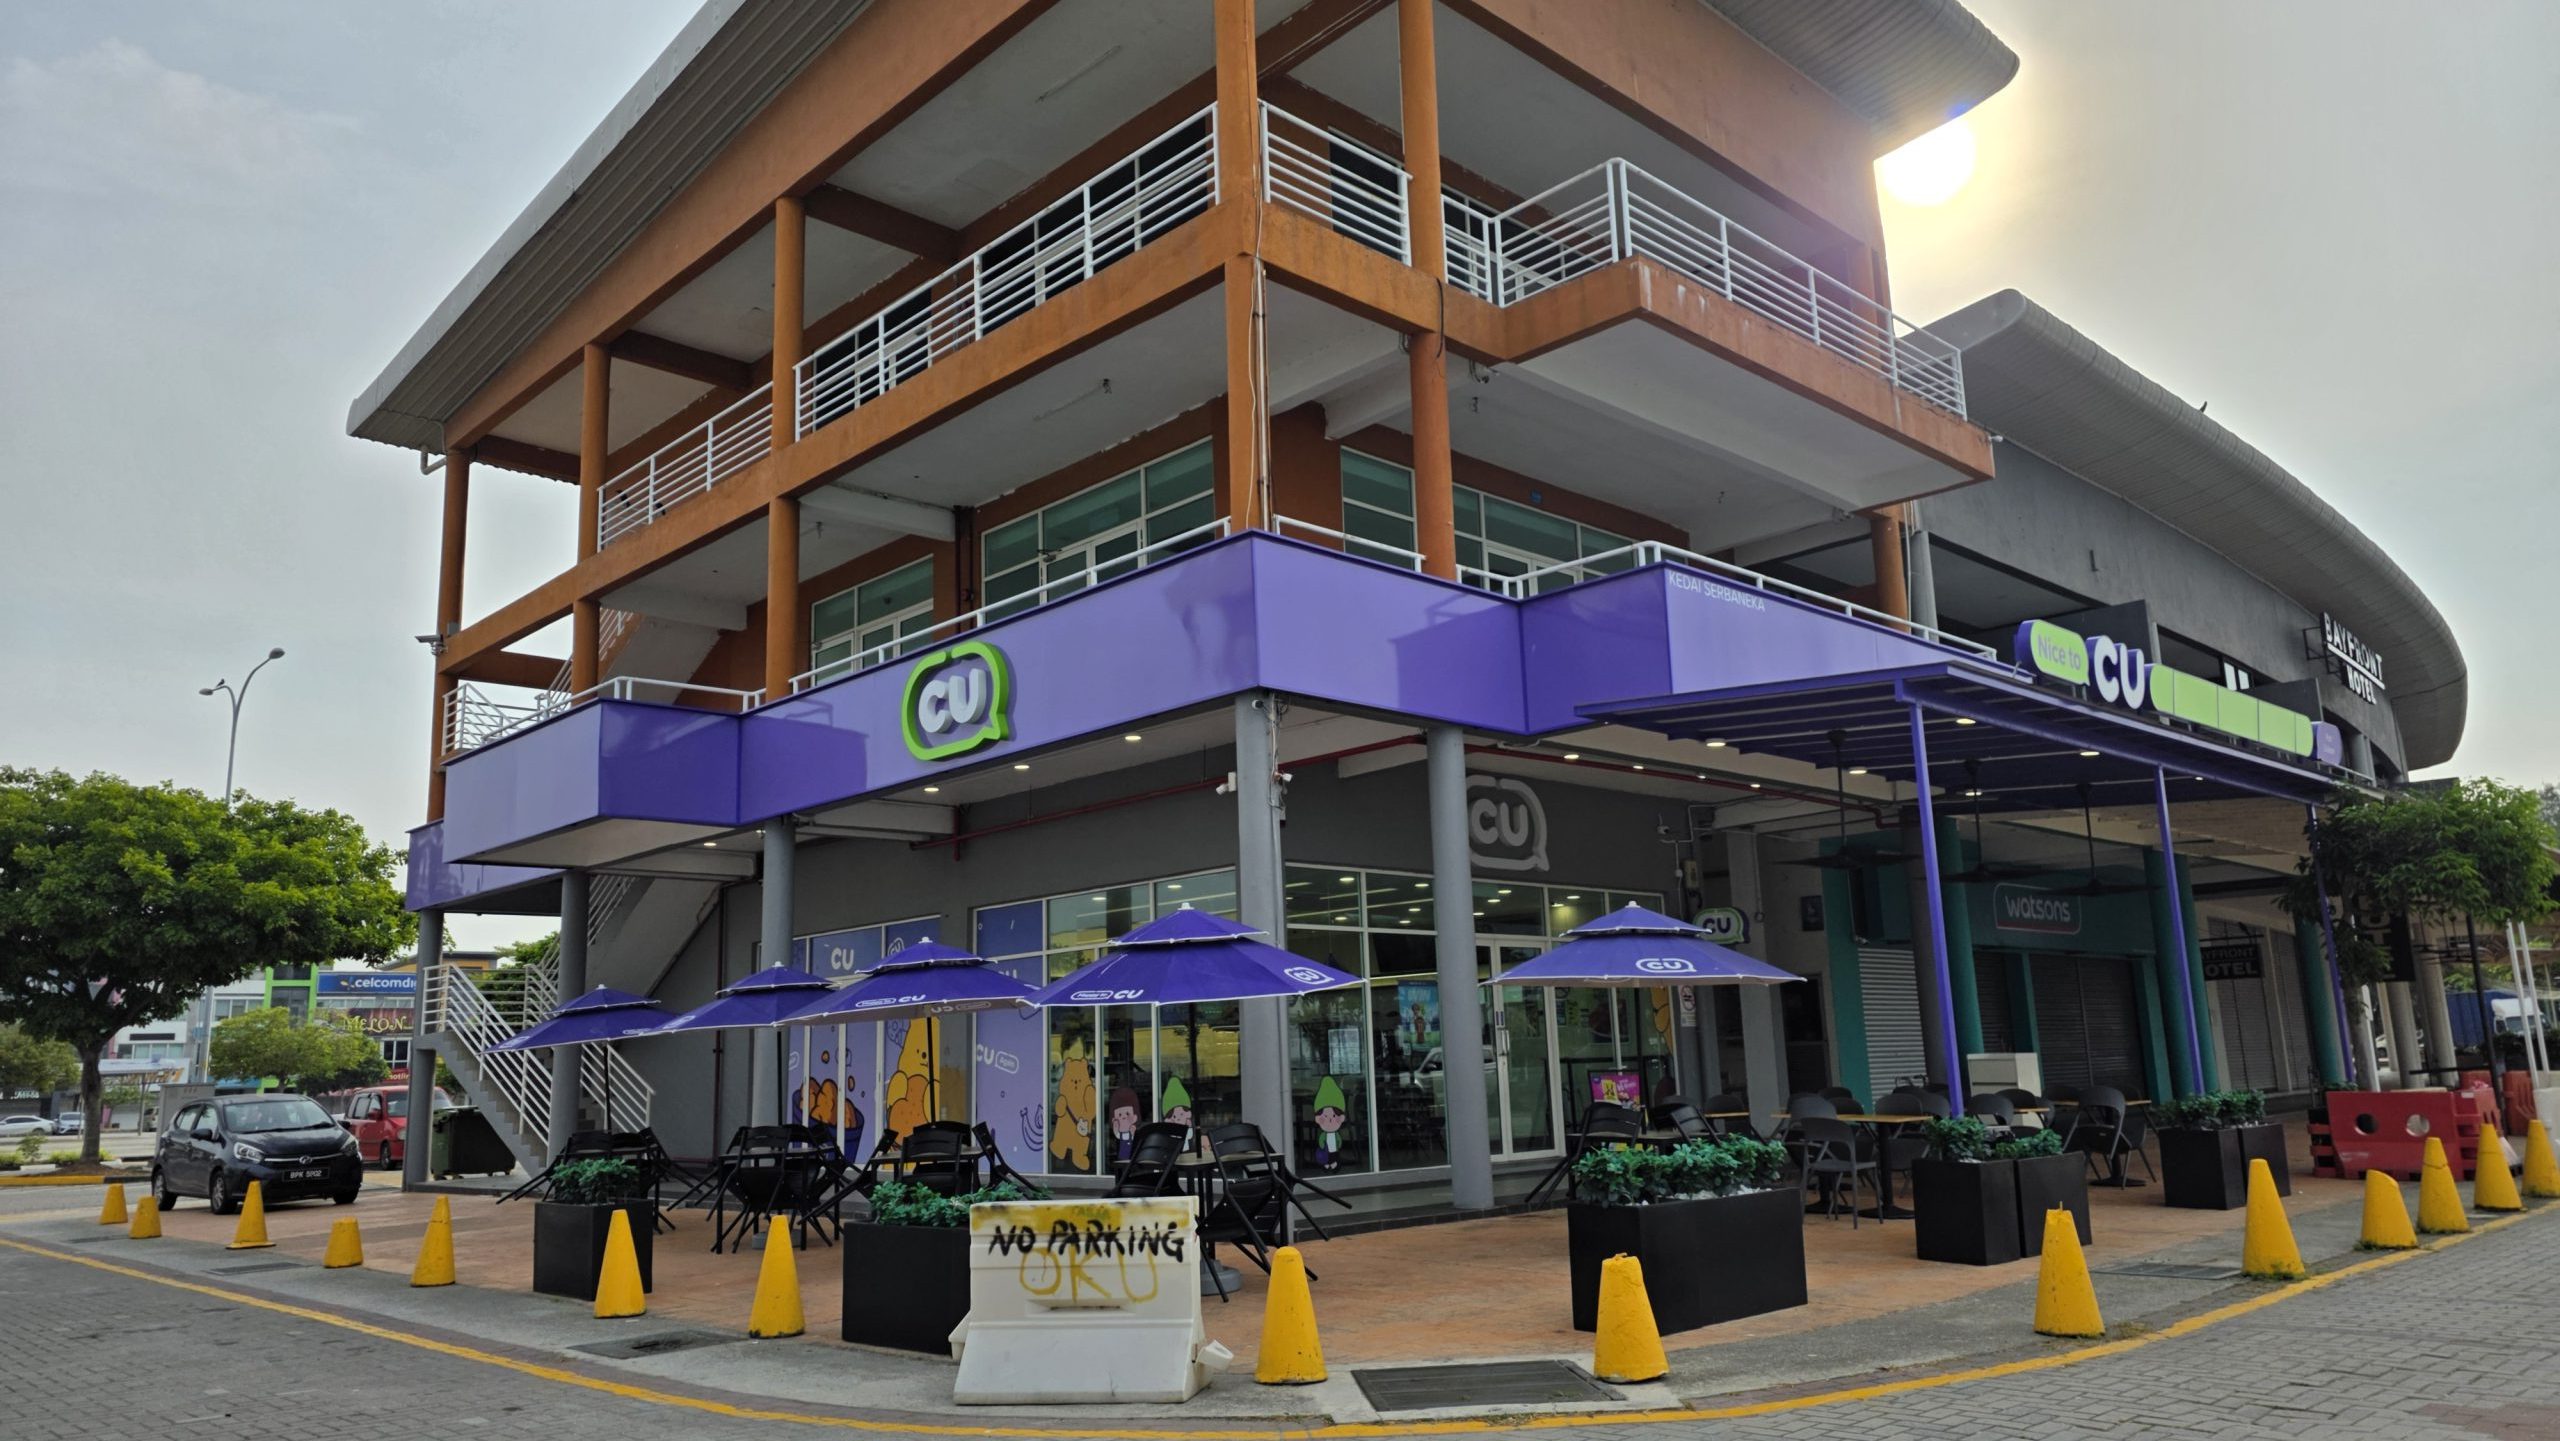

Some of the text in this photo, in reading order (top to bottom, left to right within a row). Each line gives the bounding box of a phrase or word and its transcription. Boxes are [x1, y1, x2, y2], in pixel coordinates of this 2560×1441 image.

[1668, 570, 1765, 611] KEDAI SERBANEKA
[2323, 611, 2383, 681] BAYFRONT
[2037, 634, 2146, 710] Nice to CU
[2346, 663, 2377, 705] HOTEL
[918, 667, 988, 733] CU
[1471, 798, 1529, 846] CU
[2005, 894, 2071, 922] watsons
[1702, 916, 1731, 935] CU
[831, 947, 855, 970] CU
[1646, 961, 1682, 970] CU
[2201, 947, 2256, 960] YFRONT
[2205, 962, 2257, 977] OTEL
[898, 994, 926, 1003] CU
[1113, 989, 1144, 1000] CU
[976, 1044, 995, 1065] CU
[988, 1219, 1185, 1263] NO PARKING
[1019, 1246, 1159, 1304] OKU
